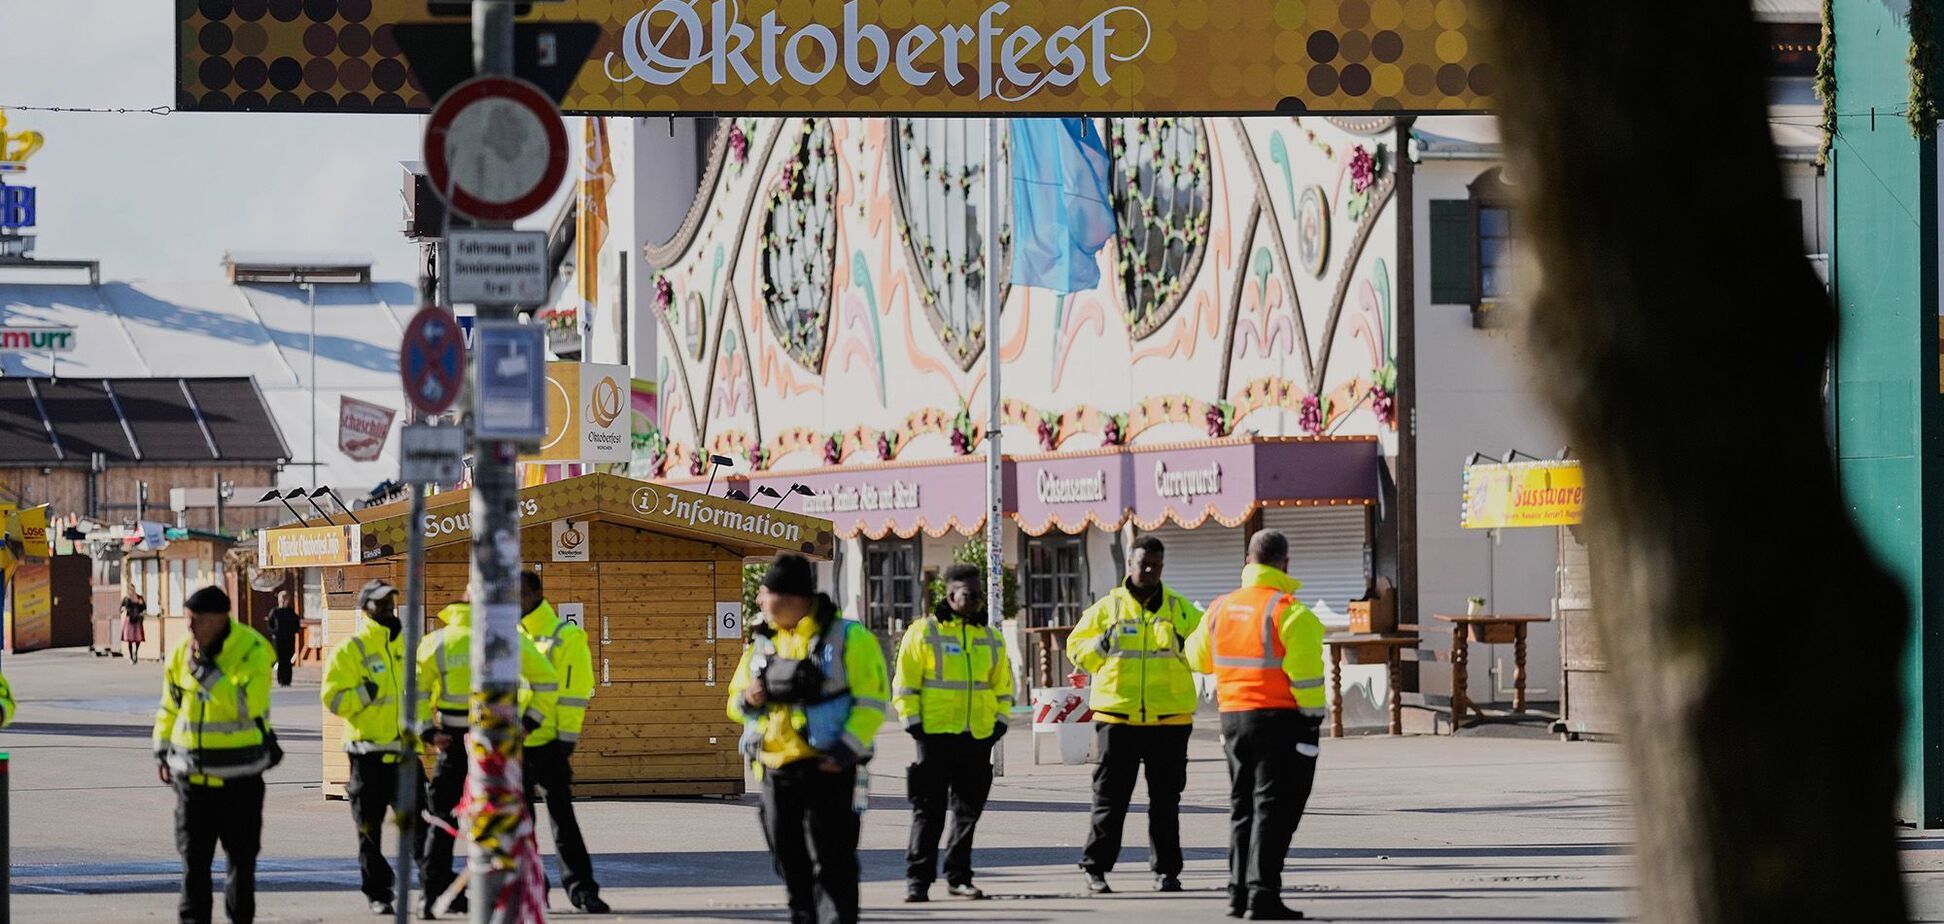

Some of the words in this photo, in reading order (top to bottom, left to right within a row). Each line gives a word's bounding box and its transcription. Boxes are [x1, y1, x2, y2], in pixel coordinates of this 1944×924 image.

[604, 0, 1151, 102] Oktoberfest
[588, 431, 622, 444] Oktoberfest
[1155, 460, 1222, 504] Currywurst
[663, 493, 800, 542] Information
[21, 522, 45, 536] Lose
[566, 613, 578, 626] 5
[723, 612, 735, 629] 6
